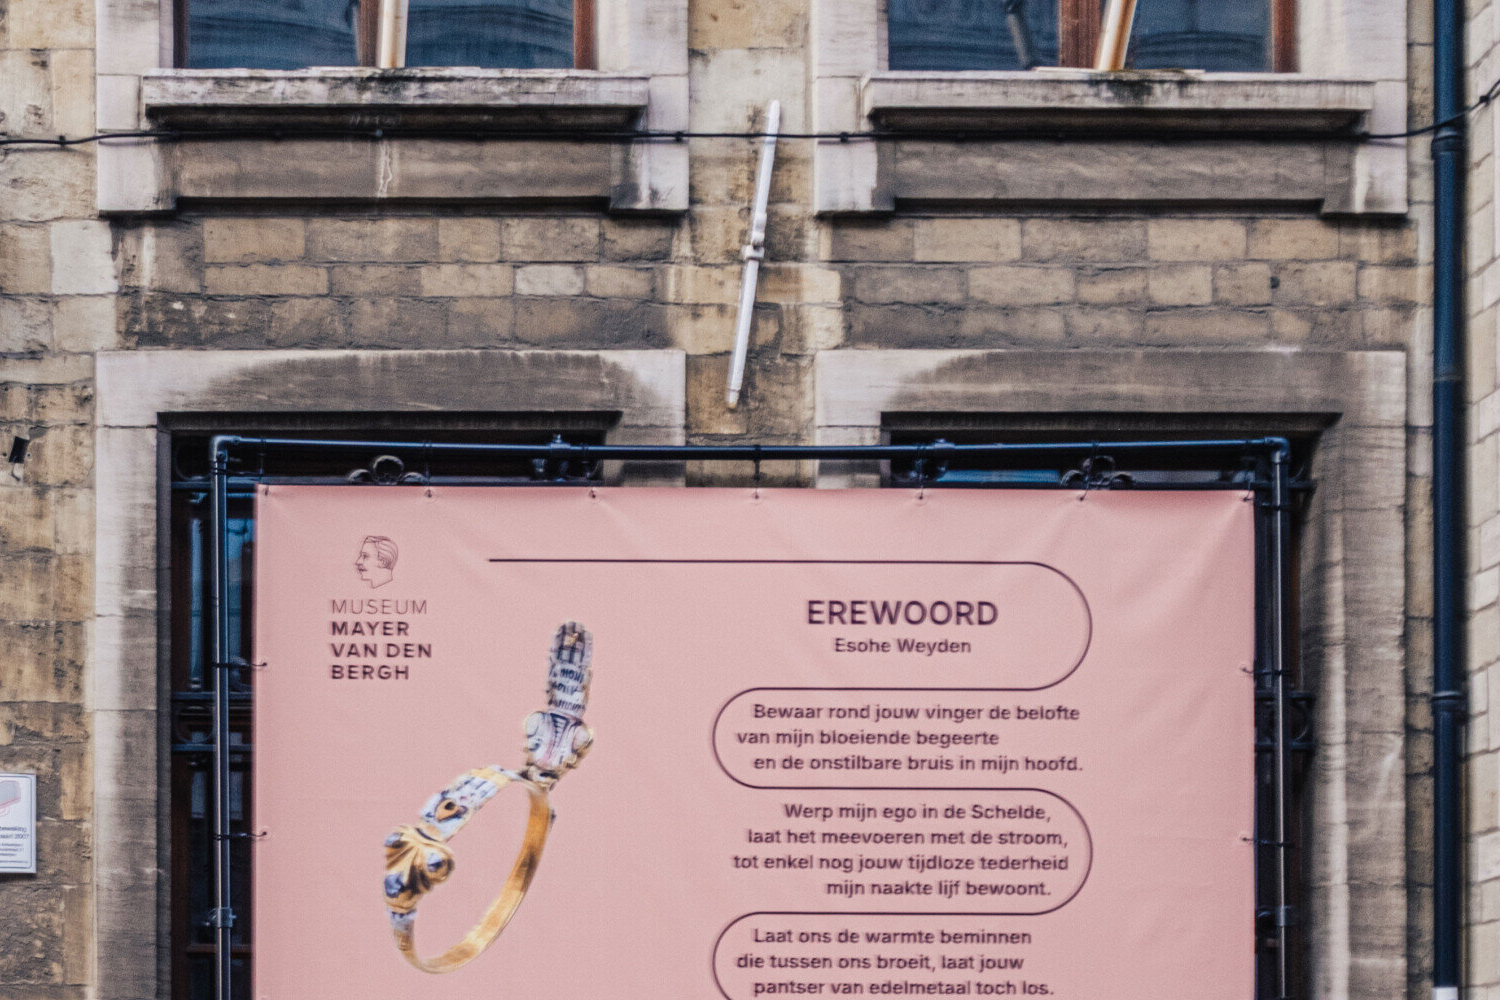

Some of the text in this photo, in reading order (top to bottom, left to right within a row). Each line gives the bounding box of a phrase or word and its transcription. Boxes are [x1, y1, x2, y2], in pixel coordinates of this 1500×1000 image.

[330, 598, 427, 615] MUSEUM
[807, 600, 998, 626] EREWOORD
[331, 621, 409, 636] MAYER
[330, 643, 431, 658] VAN DEN
[835, 638, 971, 656] Esohe Weyden
[331, 664, 409, 680] BERGH
[753, 703, 1080, 724] Bewaar rond jouw vinger de belofte
[736, 729, 999, 749] van mijn bloeiende begeerte
[753, 755, 1083, 774] en de onstilbare bruis in mijn hoofd.
[783, 803, 1050, 823] Werp mijn ego in de Schelde,
[748, 829, 1067, 848] laat het meevoeren met de stroom,
[732, 854, 1068, 873] tot enkel nog jouw tijdloze tederheid
[826, 880, 1051, 899] mijn naakte lijf bewoont.
[753, 928, 1032, 944] Laat ons de warmte beminnen
[736, 953, 1024, 973] die tussen ons broeit, laat jouw
[753, 980, 1054, 997] pantser van edelmetaal toch los.
